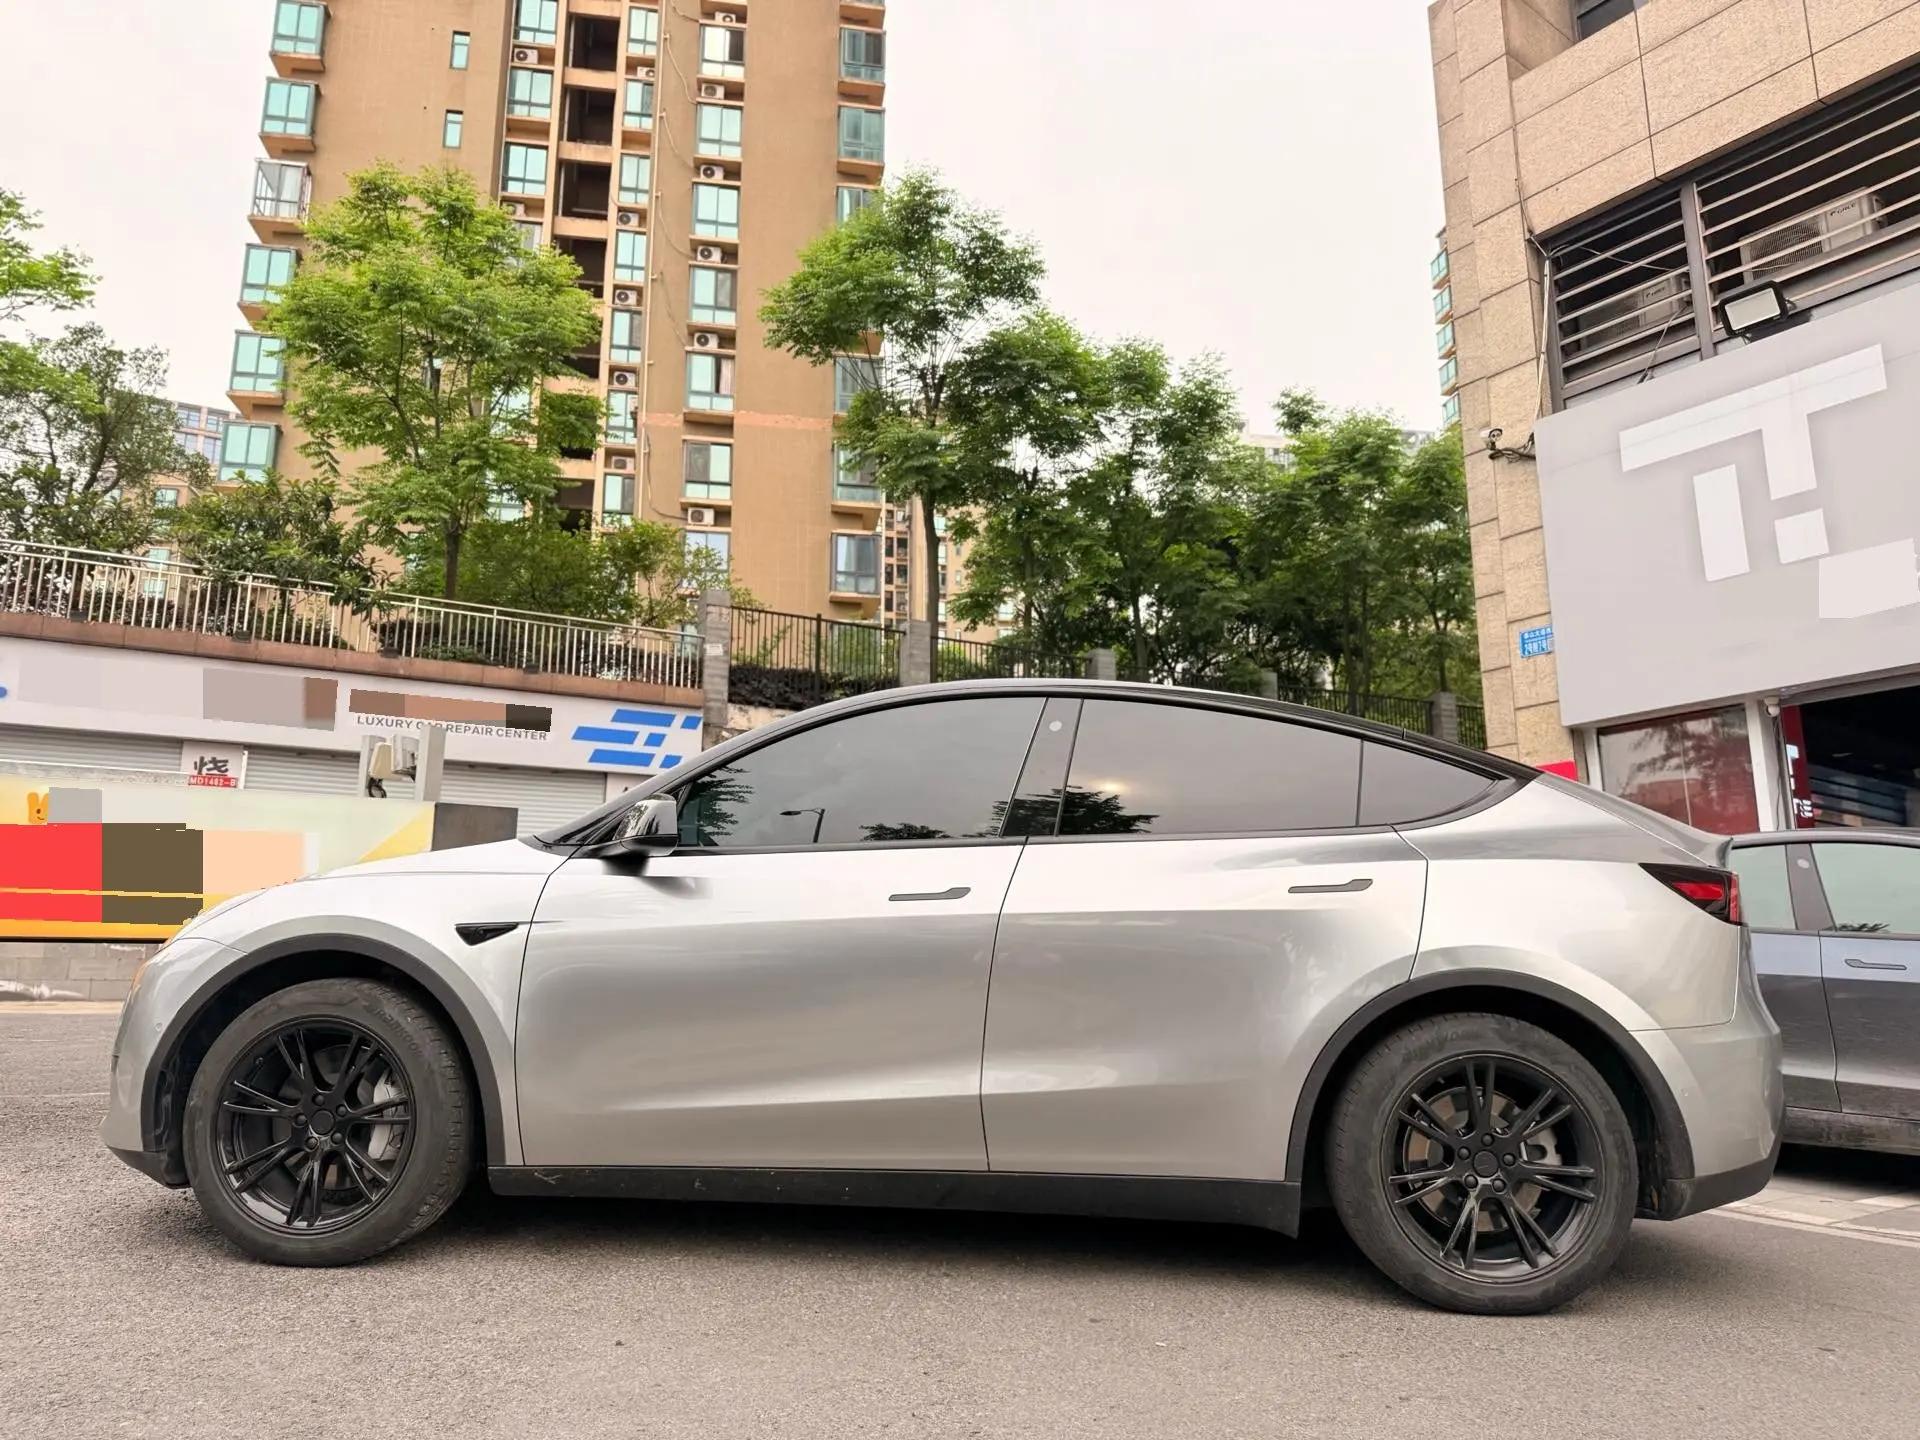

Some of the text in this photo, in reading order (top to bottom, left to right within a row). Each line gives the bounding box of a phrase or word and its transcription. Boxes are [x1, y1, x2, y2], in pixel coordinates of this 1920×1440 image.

[357, 716, 413, 729] LUXURY
[445, 723, 493, 737] REPAIR
[496, 727, 549, 740] CENTER
